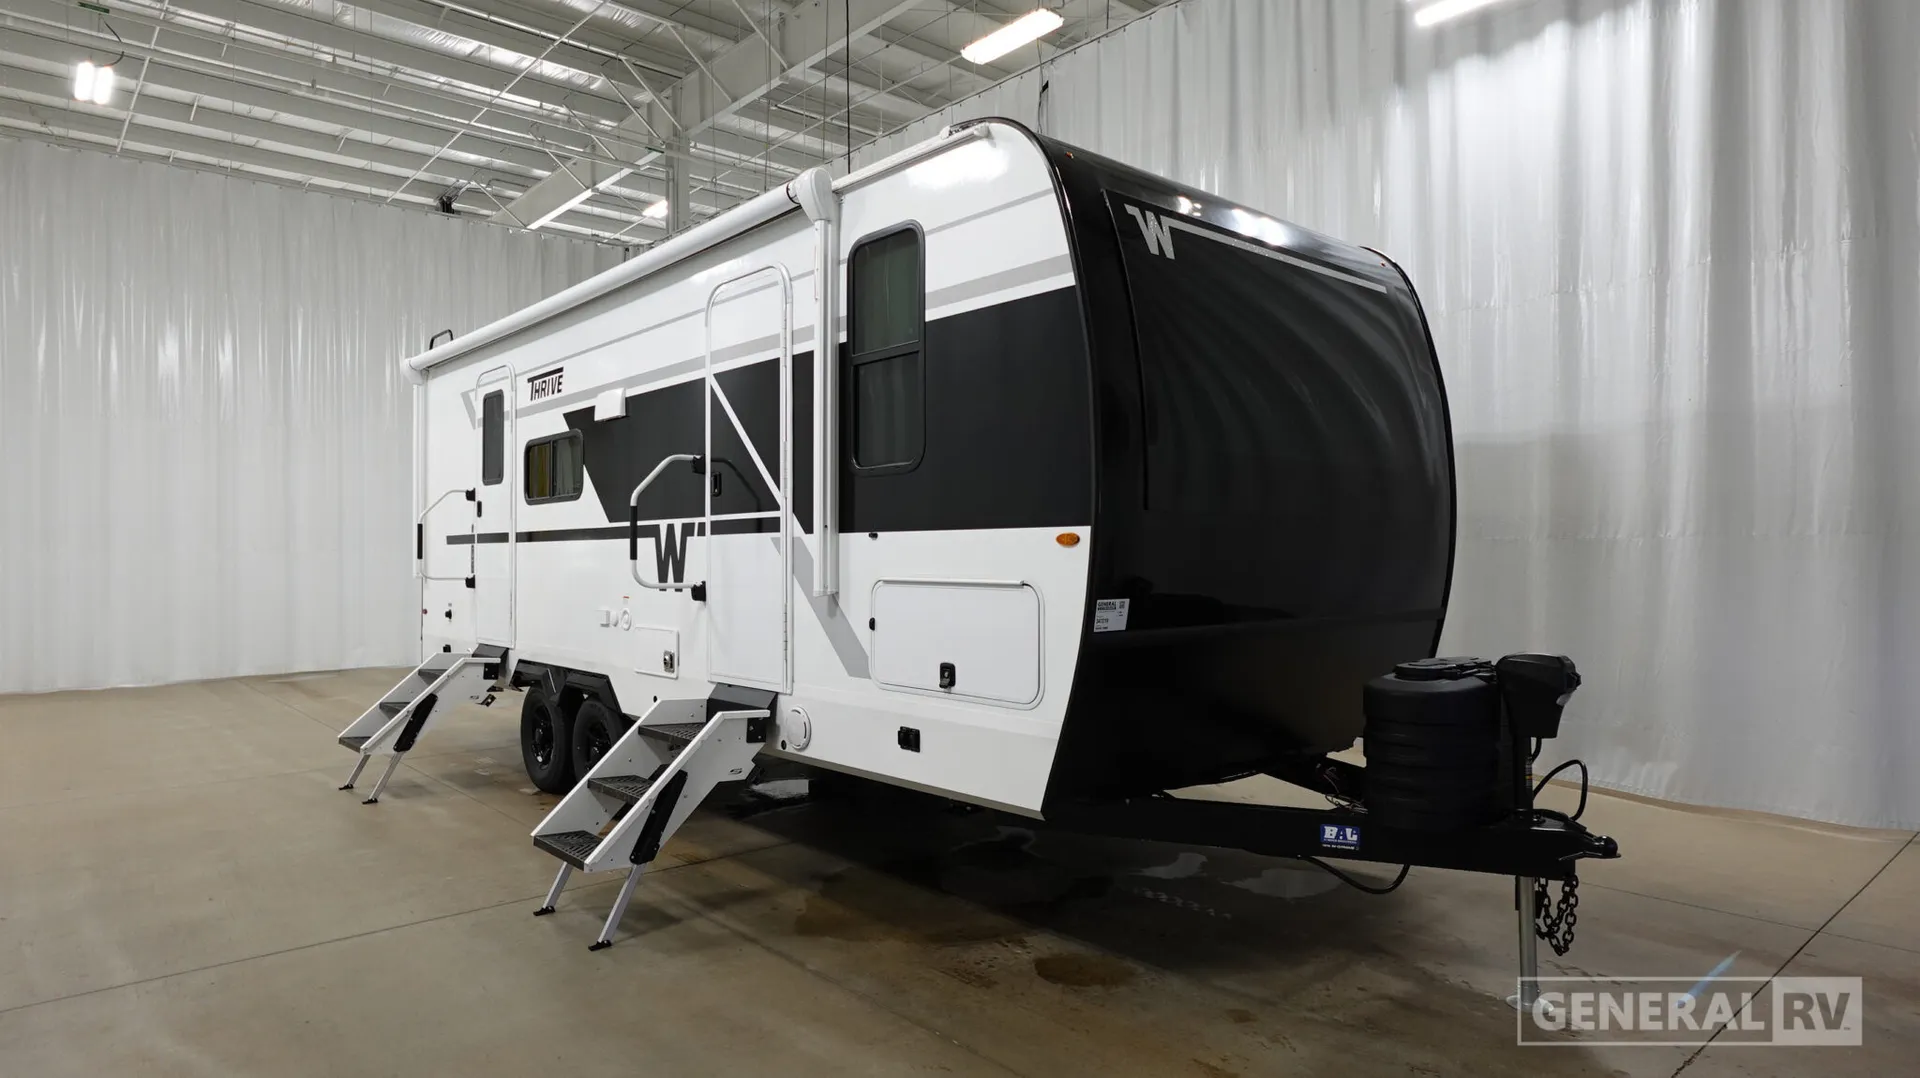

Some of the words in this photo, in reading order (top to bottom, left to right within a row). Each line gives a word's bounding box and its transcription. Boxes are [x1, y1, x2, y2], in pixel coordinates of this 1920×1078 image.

[1124, 203, 1175, 260] W
[527, 366, 564, 401] THRIVE
[654, 521, 696, 592] W
